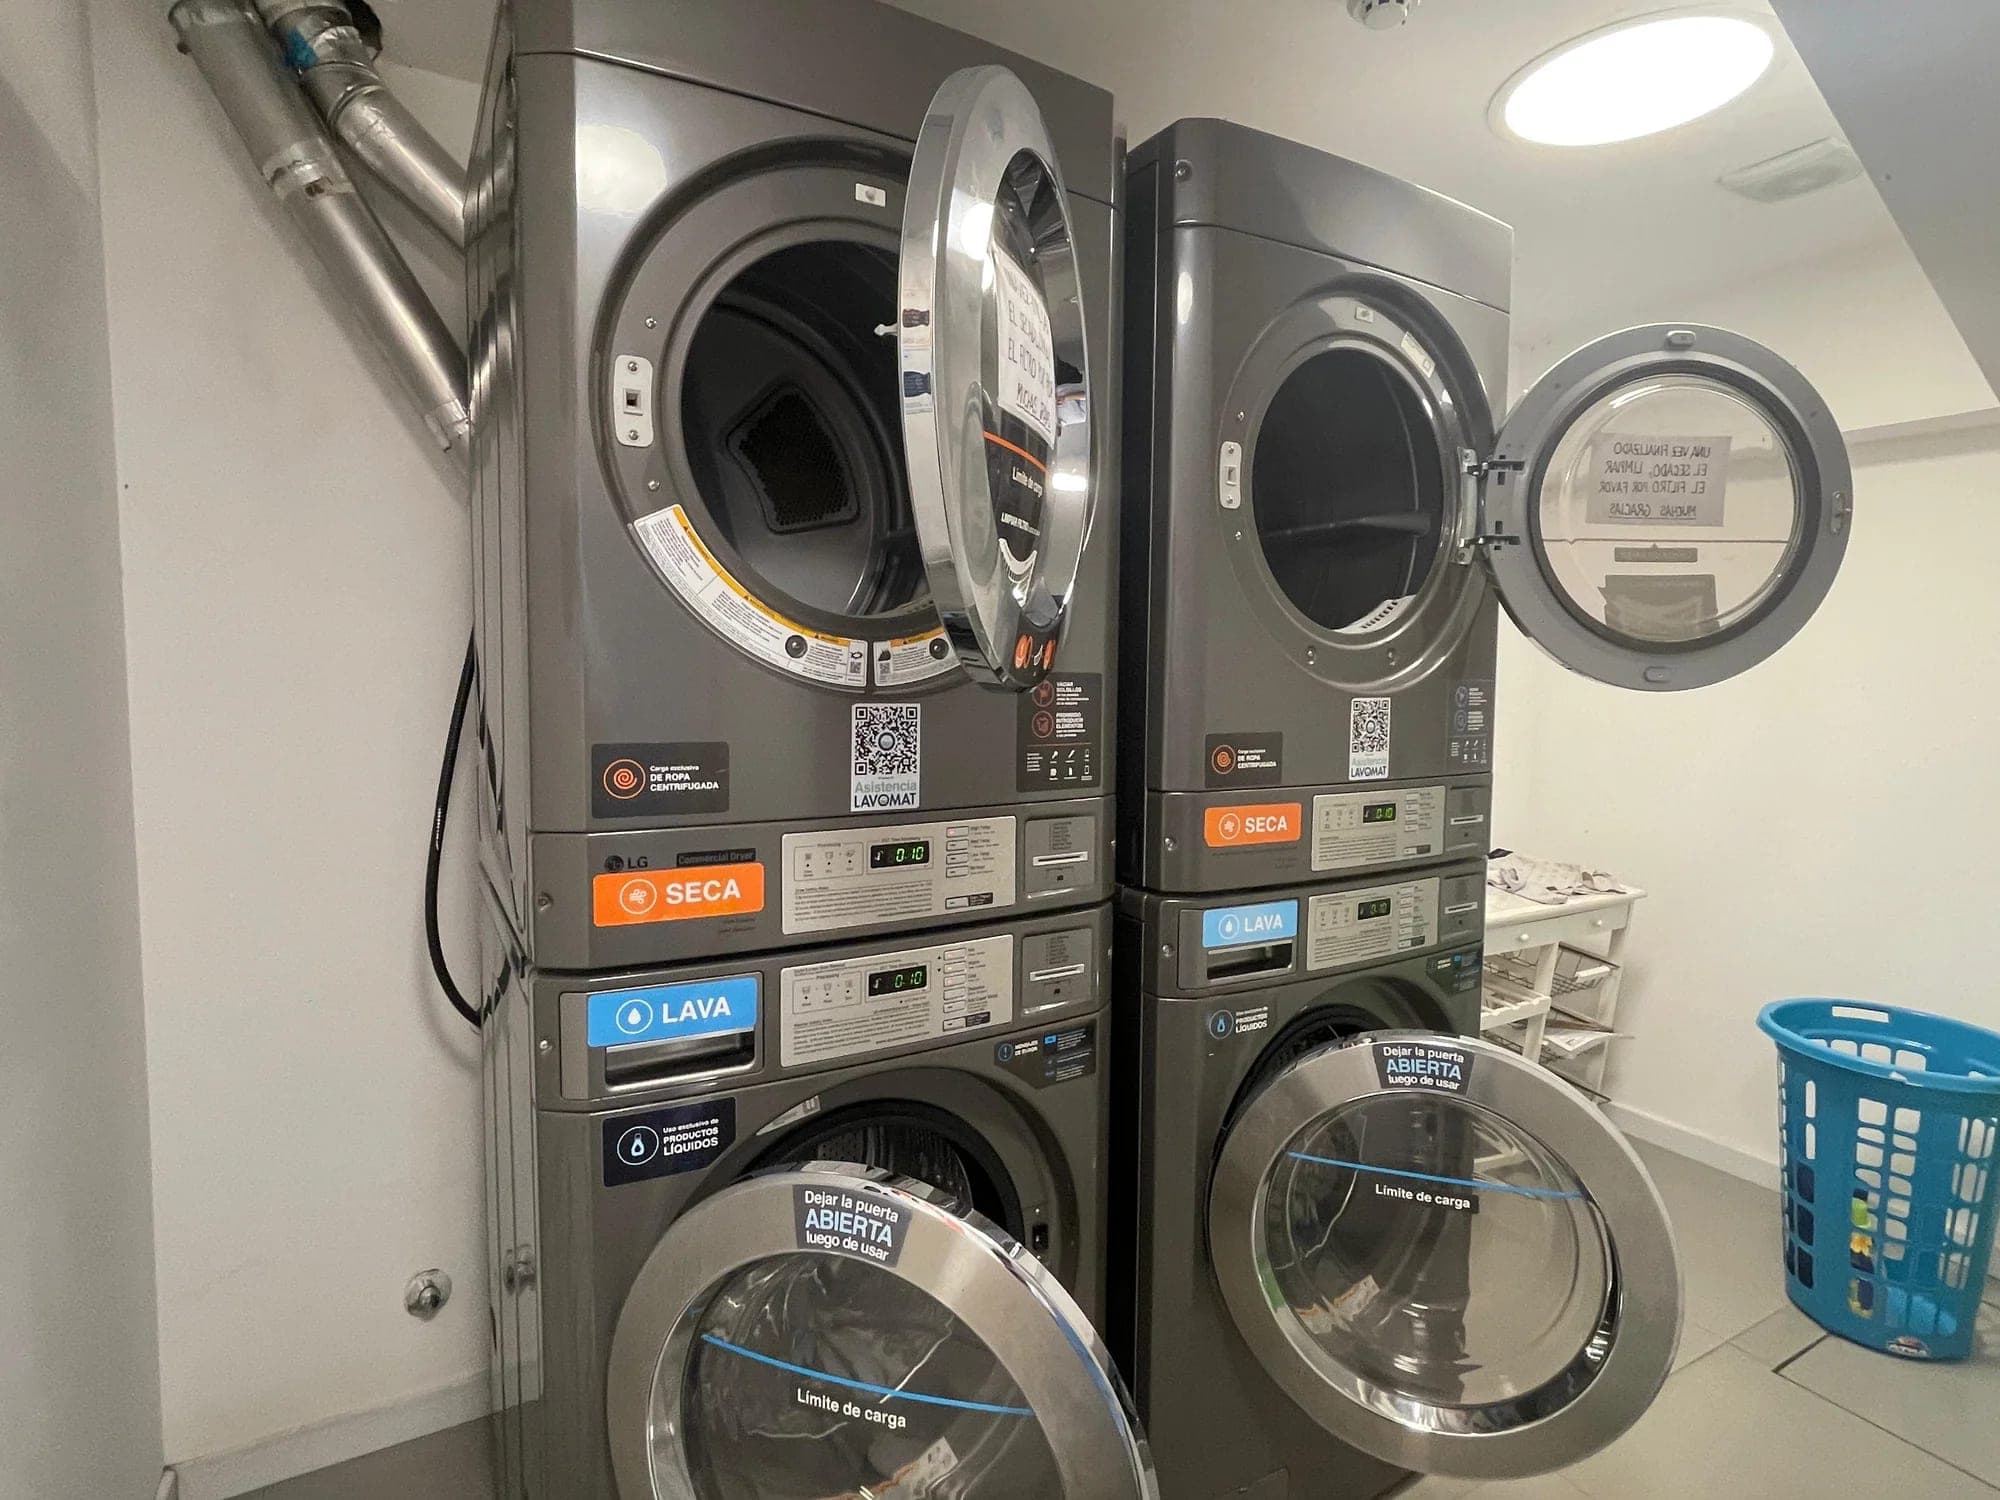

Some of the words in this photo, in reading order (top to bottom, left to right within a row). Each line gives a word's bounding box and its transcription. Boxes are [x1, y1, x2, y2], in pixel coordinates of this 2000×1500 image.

[650, 773, 663, 782] DE
[665, 773, 690, 782] ROPA
[1351, 766, 1387, 778] LAVOMAT
[650, 781, 719, 792] CENTRIFUGADA
[855, 781, 917, 793] Asistencia
[854, 793, 917, 809] LAVOMAT
[1245, 815, 1288, 834] SECA
[627, 856, 648, 868] LG
[666, 879, 742, 905] SECA
[1244, 913, 1284, 933] LAVA
[662, 996, 732, 1024] LAVA
[1383, 1046, 1413, 1058] Dejar
[1415, 1046, 1425, 1057] la
[1427, 1049, 1464, 1063] puerta
[1386, 1058, 1461, 1080] ABIERTA
[1388, 1074, 1418, 1086] luego
[1420, 1075, 1434, 1086] de
[1435, 1079, 1460, 1090] usar
[663, 1126, 677, 1134] Uso
[663, 1127, 719, 1144] PRODUCTOS
[664, 1136, 719, 1156] LÍQUIDOS
[805, 1190, 839, 1208] Dejar
[841, 1194, 853, 1209] la
[855, 1200, 899, 1223] puerta
[1416, 1191, 1432, 1203] de
[1434, 1195, 1471, 1210] carga
[805, 1208, 892, 1248] ABIERTA
[806, 1230, 840, 1248] luego
[842, 1237, 859, 1251] de
[861, 1243, 889, 1261] usar
[843, 1401, 860, 1418] de
[864, 1409, 906, 1430] carga
